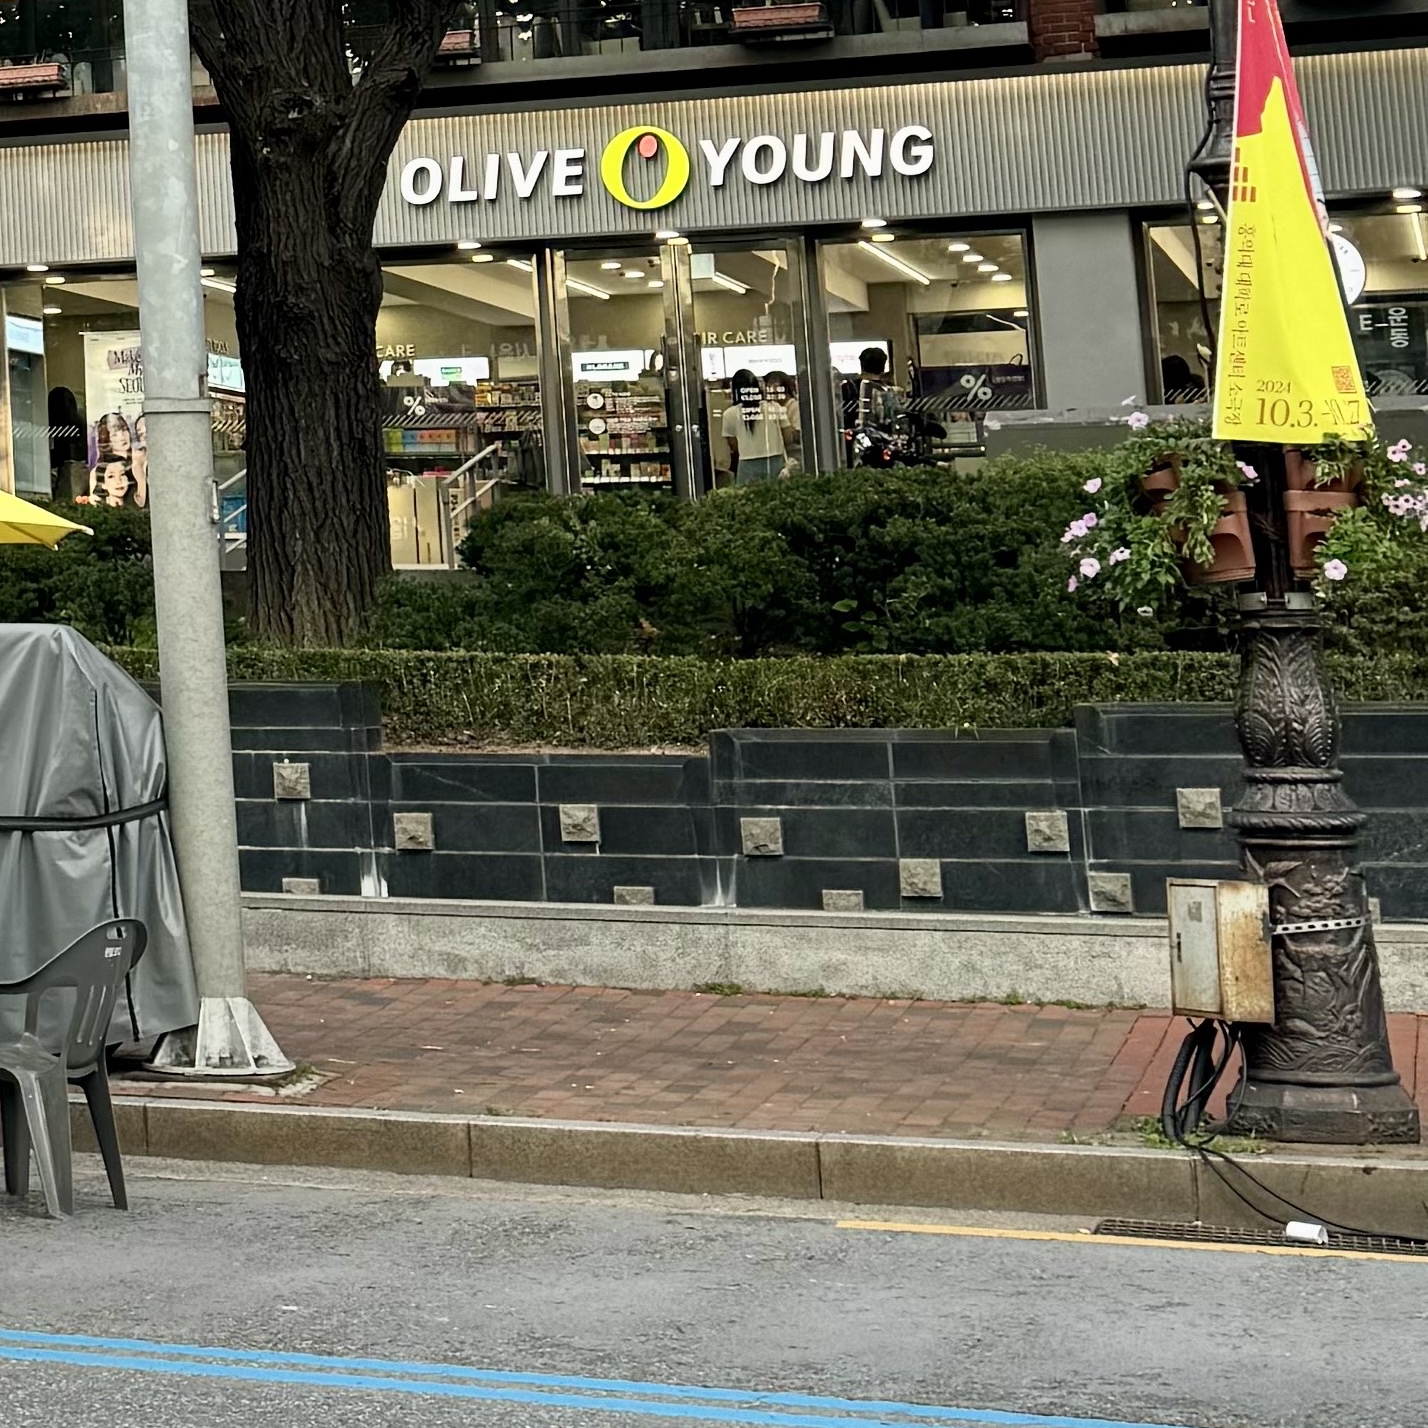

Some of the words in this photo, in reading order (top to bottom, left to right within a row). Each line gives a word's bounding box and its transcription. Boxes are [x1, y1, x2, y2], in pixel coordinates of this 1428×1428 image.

[400, 147, 584, 206] OLIVE
[698, 124, 935, 186] YOUNG
[723, 329, 767, 345] CARE
[1256, 379, 1291, 394] 2024
